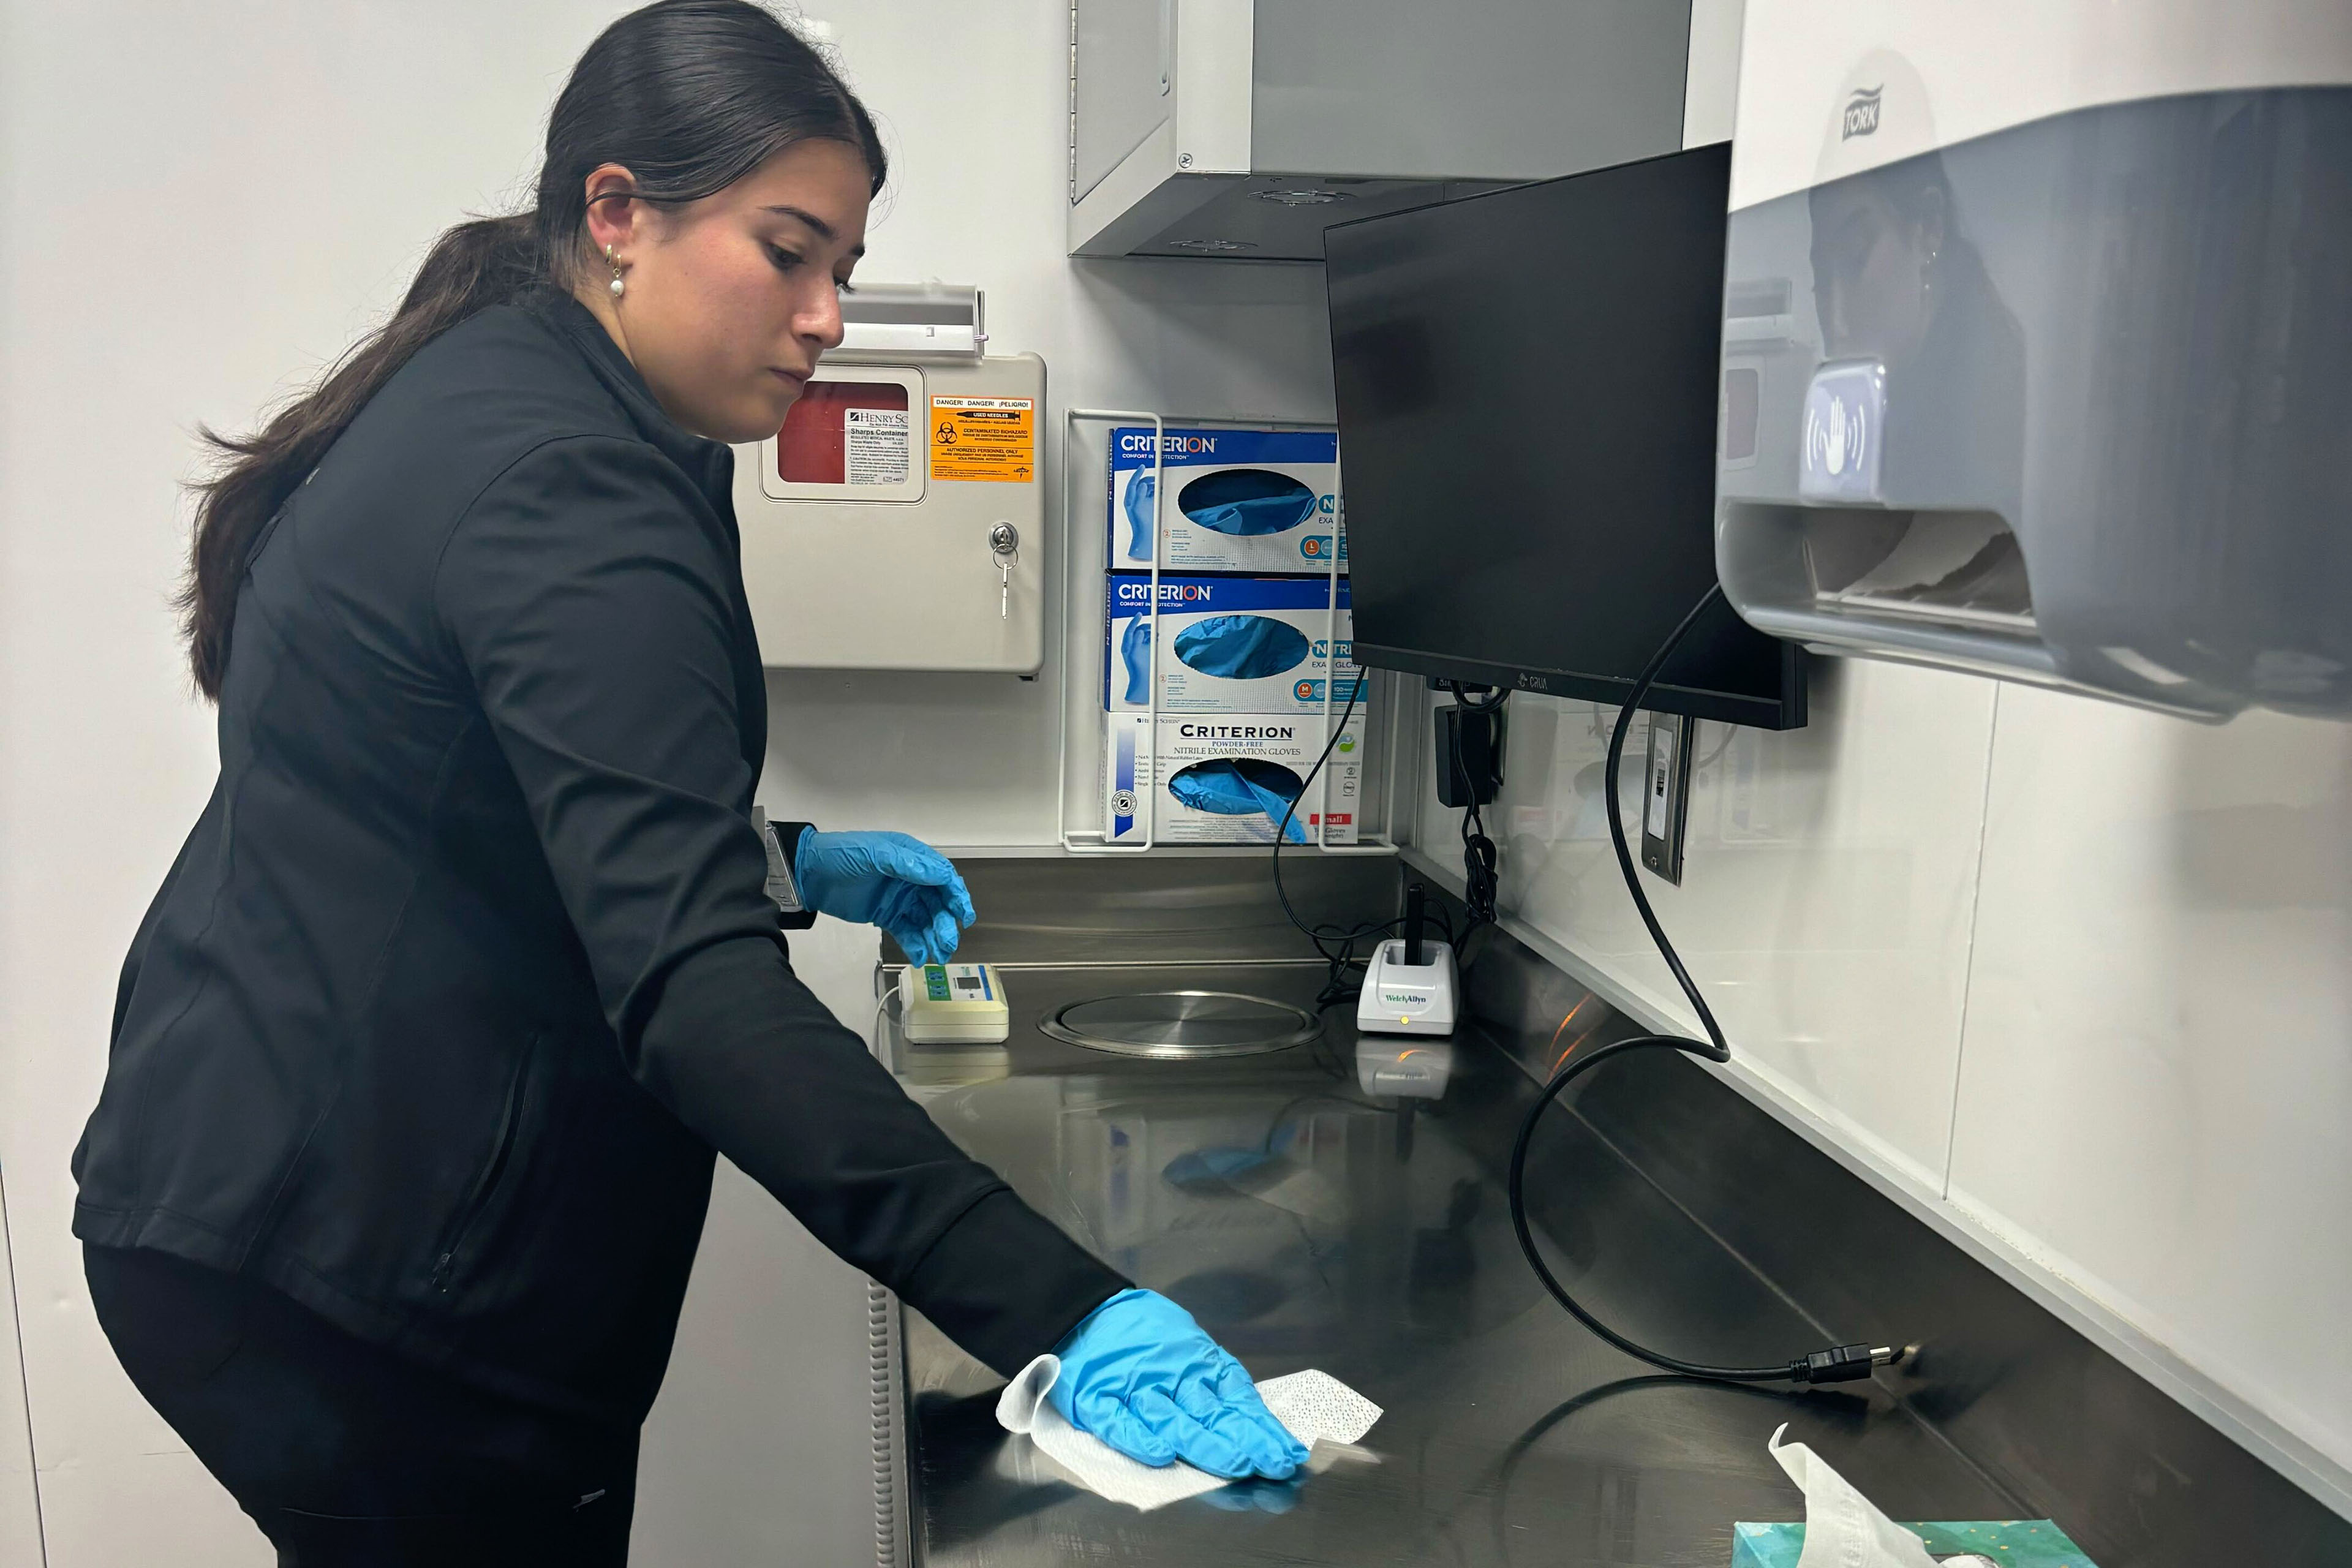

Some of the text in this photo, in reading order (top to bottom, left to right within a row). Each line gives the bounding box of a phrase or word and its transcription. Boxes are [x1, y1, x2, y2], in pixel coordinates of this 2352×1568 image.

[1845, 102, 1879, 134] TORK
[861, 412, 894, 423] HENRY
[1121, 435, 1215, 453] CRITERION
[1118, 584, 1210, 601] CRITERION
[1180, 724, 1292, 738] CRITERION
